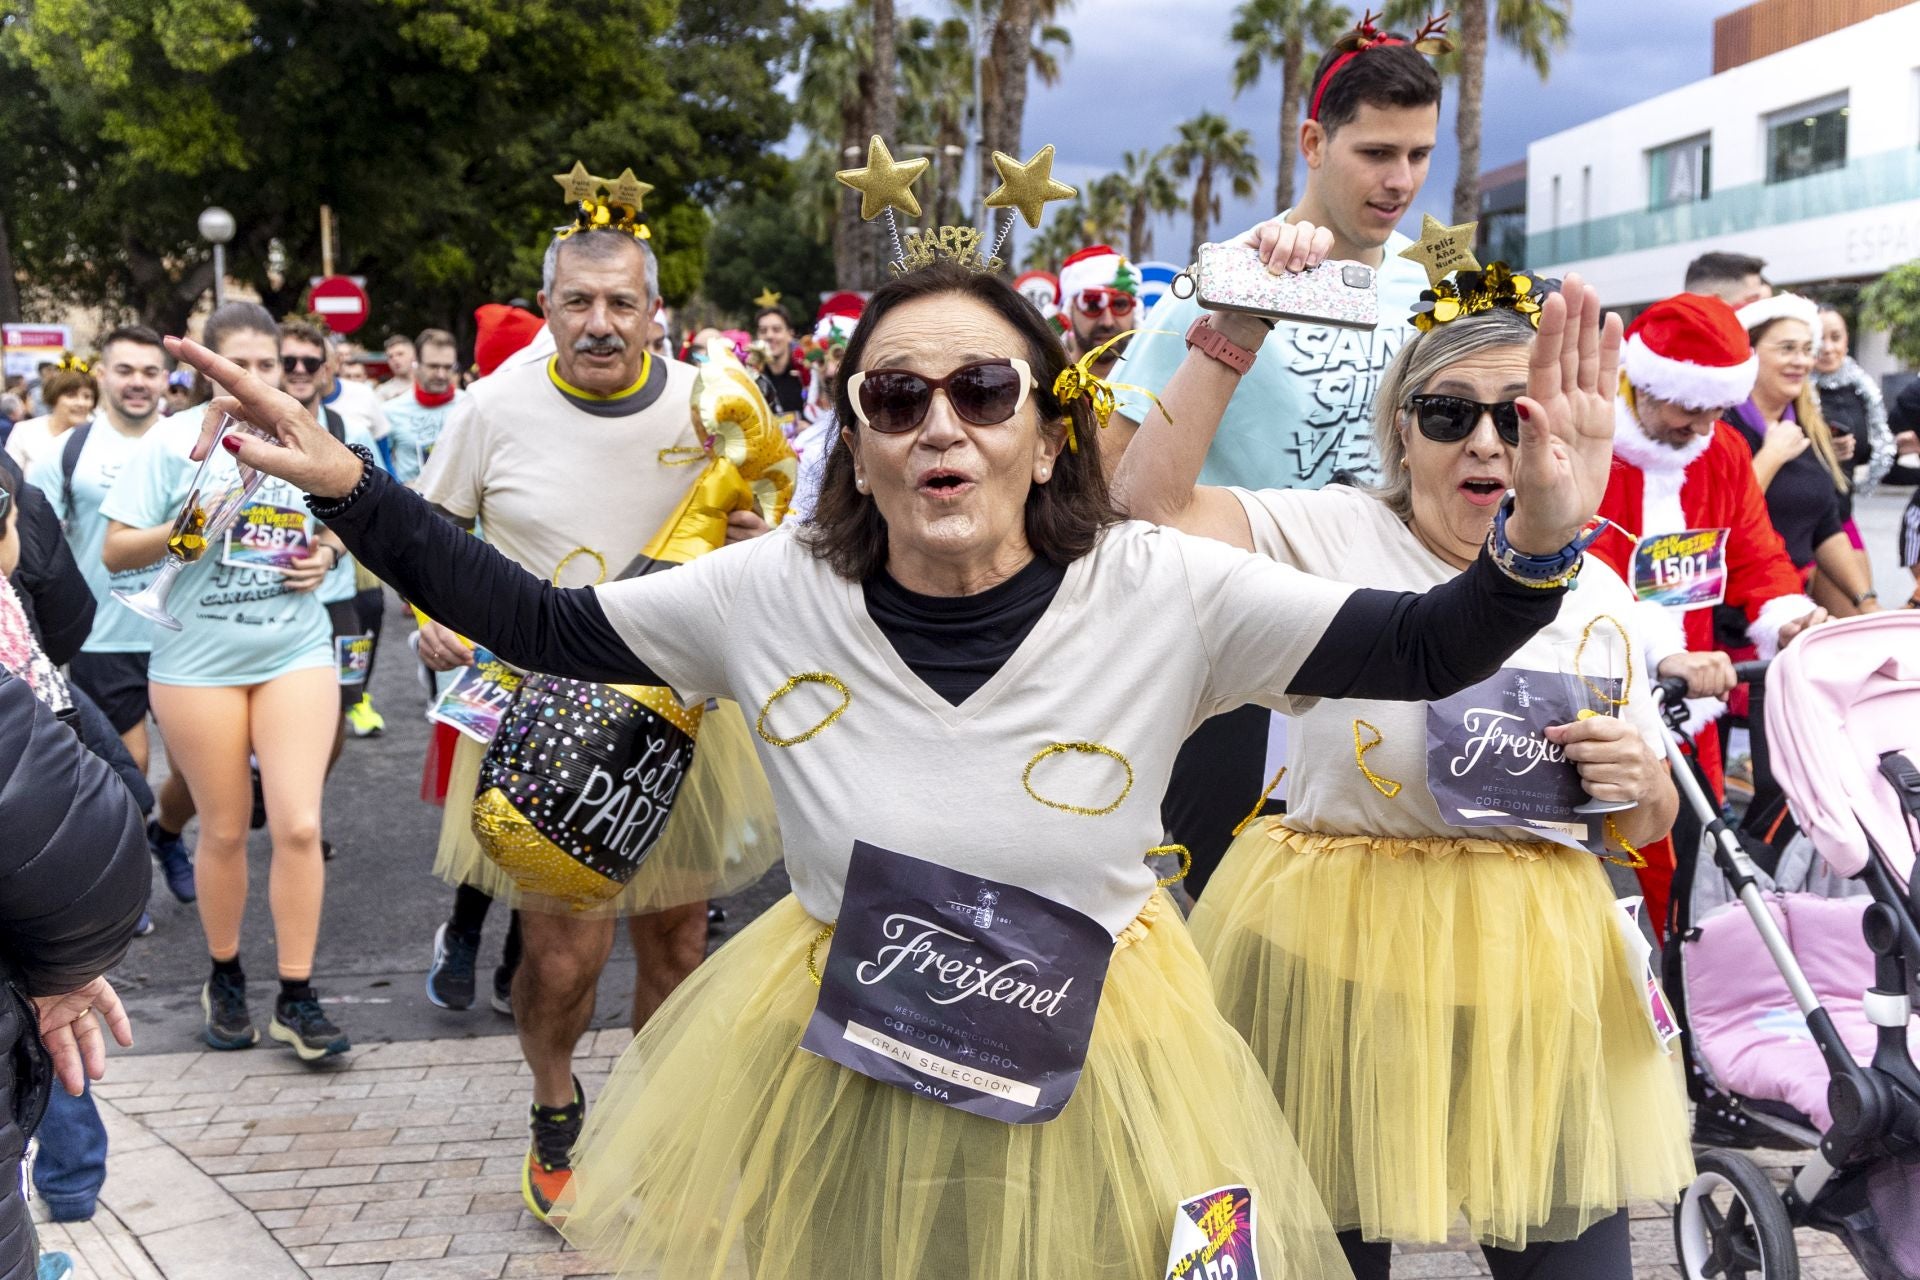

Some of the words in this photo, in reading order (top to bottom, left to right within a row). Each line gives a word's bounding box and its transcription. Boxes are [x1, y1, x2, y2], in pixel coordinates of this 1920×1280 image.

[903, 225, 985, 262] HAPPY
[1426, 237, 1456, 254] Feliz
[1436, 248, 1456, 260] Año
[1435, 254, 1463, 269] Nuevo
[240, 522, 304, 552] 2587
[1650, 554, 1709, 586] 1501
[1450, 708, 1574, 777] Freixe
[1475, 796, 1531, 811] CORDON
[1535, 804, 1570, 816] NEGRO
[856, 913, 1075, 1018] Freixenet
[884, 1016, 952, 1050] CORDON
[957, 1044, 1013, 1069] NEGRO
[941, 1023, 1011, 1052] TRADICIONAL
[871, 1037, 912, 1061] GRAN
[919, 1058, 1013, 1094] SELECCIÓN
[914, 1080, 950, 1101] CAVA
